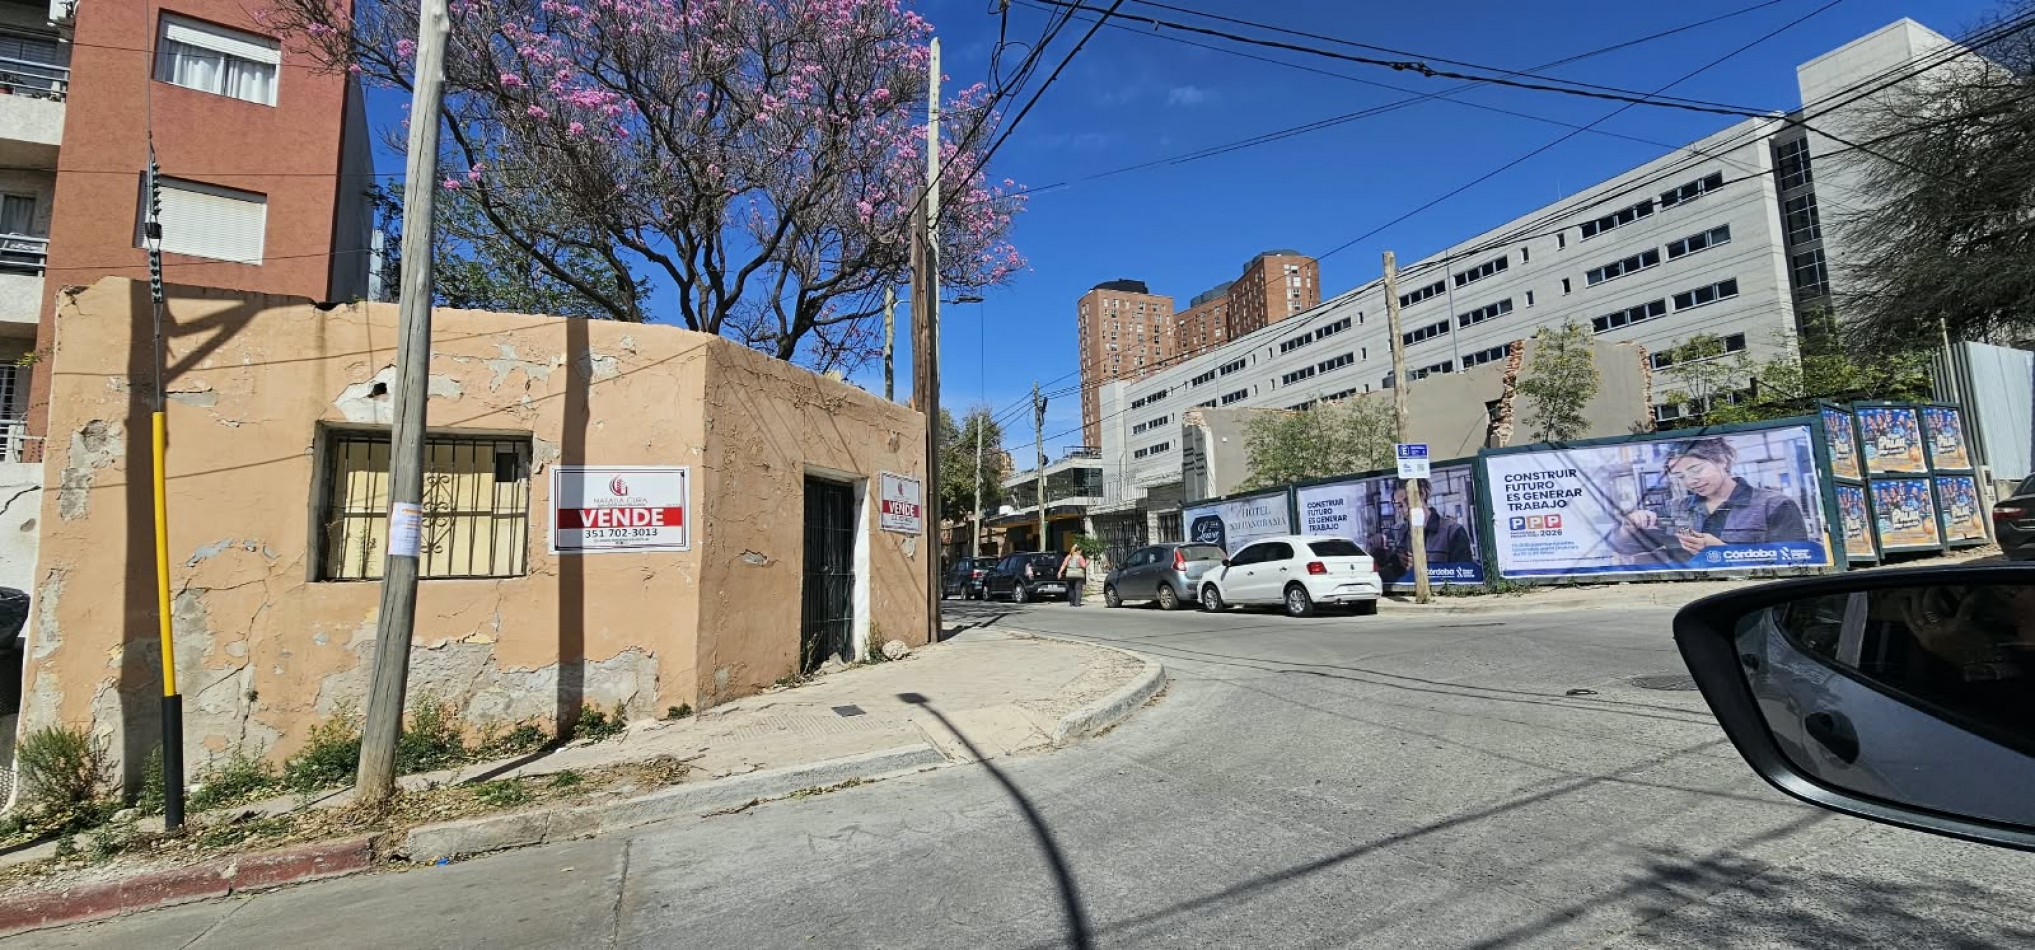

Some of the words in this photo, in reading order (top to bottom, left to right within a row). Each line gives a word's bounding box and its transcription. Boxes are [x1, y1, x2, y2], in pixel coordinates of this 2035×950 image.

[1504, 469, 1577, 482] CONSTRUIR
[1505, 481, 1555, 492] FUTURO
[1507, 493, 1520, 502] ES
[1523, 488, 1582, 500] GENERAR
[889, 500, 914, 516] VENDE
[1307, 498, 1344, 509] CONSTRUIR
[1507, 500, 1567, 511] TRABAJO
[578, 508, 664, 527] VENDE
[1308, 508, 1333, 517] FUTURO
[1308, 517, 1315, 525] ES
[1316, 515, 1348, 523] GENERAR
[585, 530, 604, 538] 351
[608, 528, 658, 537] 702-3013
[1309, 523, 1339, 532] TRABAJO
[1723, 549, 1777, 559] Córdoba
